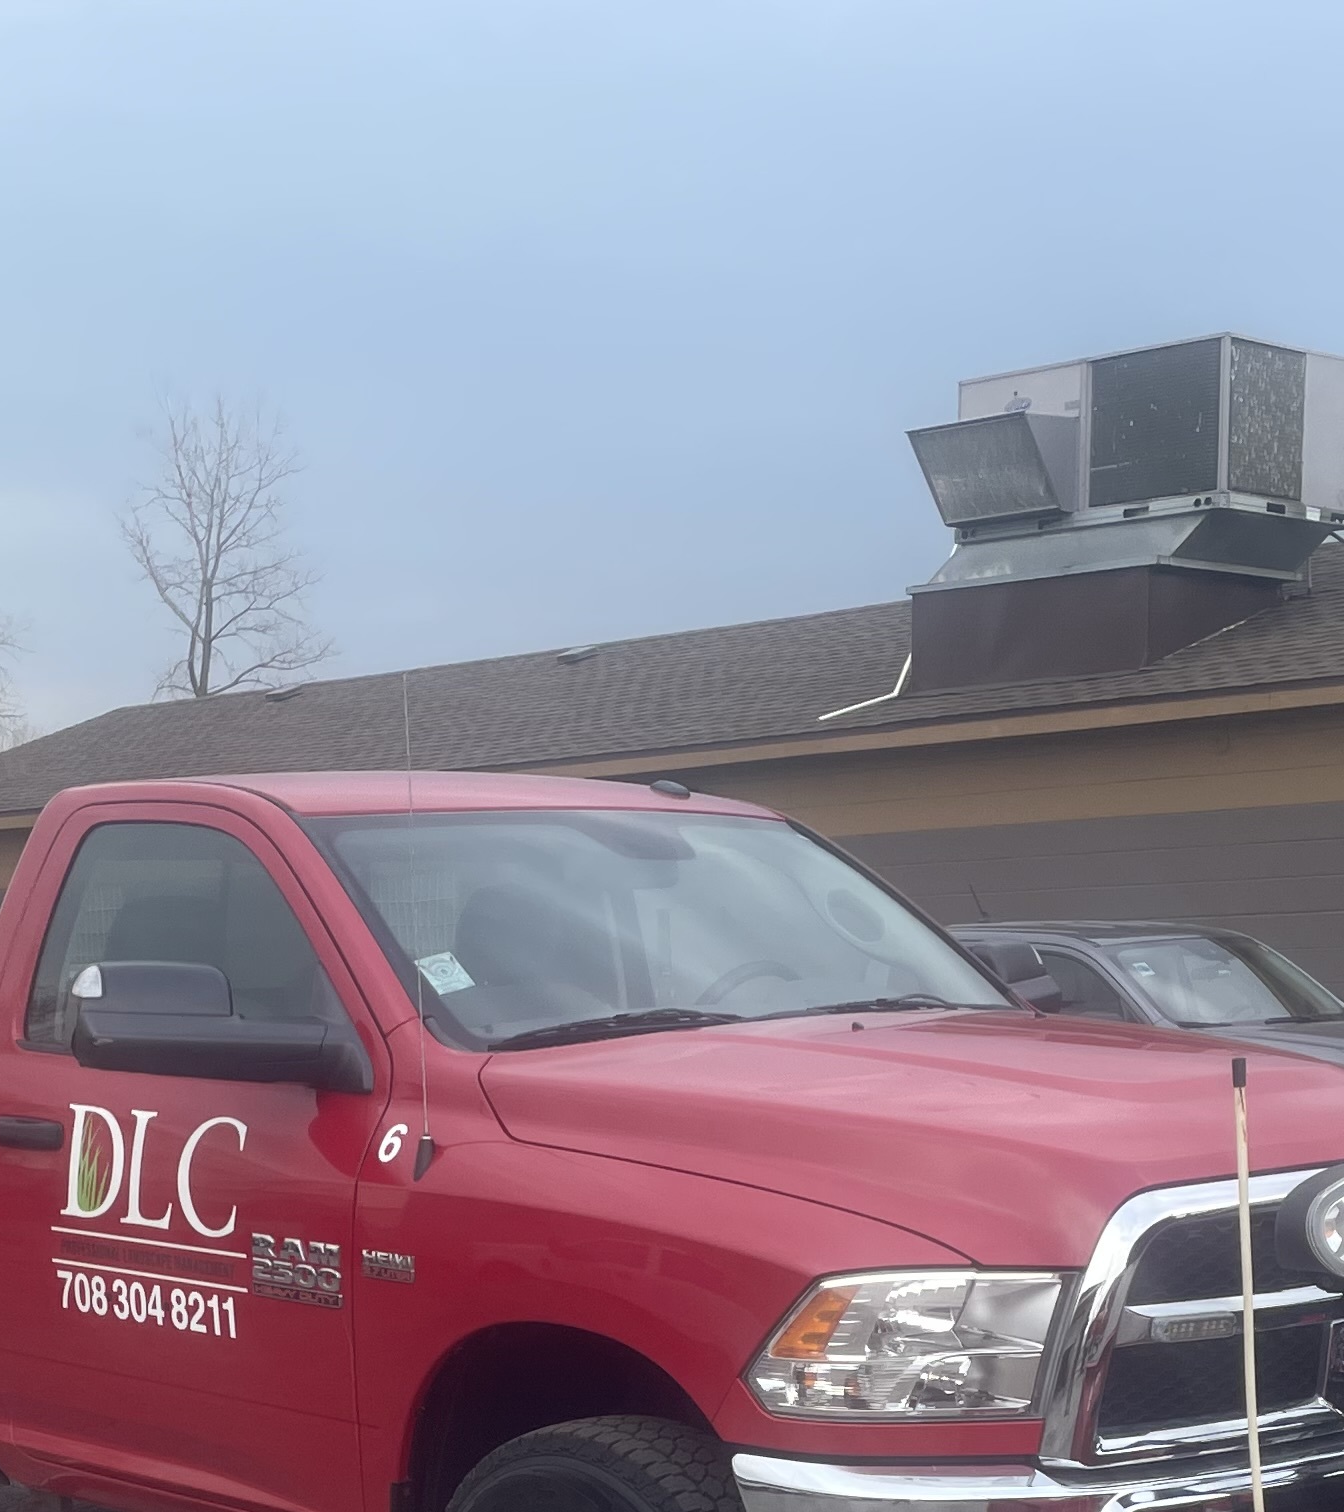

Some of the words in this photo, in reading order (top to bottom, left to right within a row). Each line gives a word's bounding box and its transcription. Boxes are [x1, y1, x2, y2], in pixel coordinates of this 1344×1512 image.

[378, 1123, 408, 1162] 6
[60, 1103, 247, 1238] DLC
[252, 1232, 340, 1267] RAM
[252, 1257, 341, 1292] 2500
[57, 1270, 108, 1316] 708
[112, 1279, 165, 1326] 304
[170, 1288, 236, 1339] 8211
